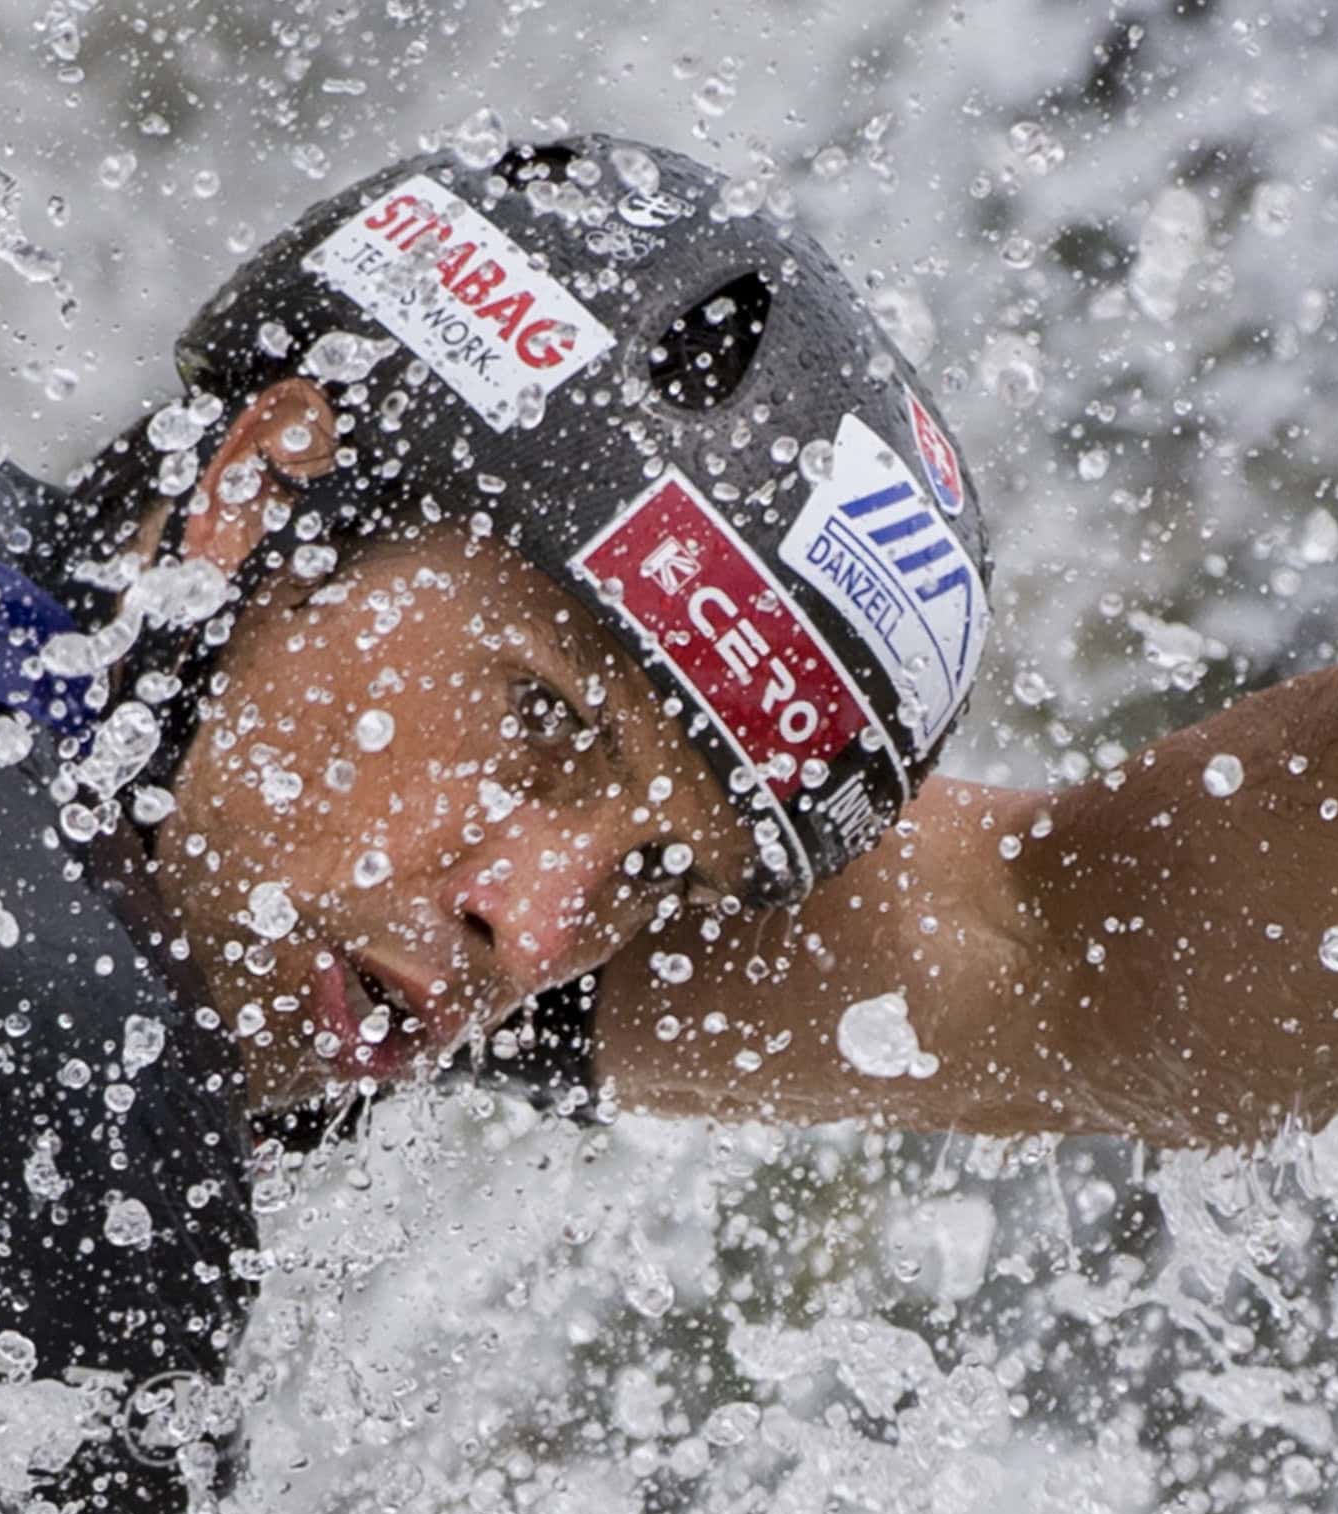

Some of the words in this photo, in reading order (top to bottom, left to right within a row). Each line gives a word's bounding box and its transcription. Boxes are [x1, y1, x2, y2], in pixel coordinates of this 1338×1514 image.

[341, 241, 417, 306] TES
[364, 195, 575, 369] STRABAG
[687, 586, 819, 744] CERO
